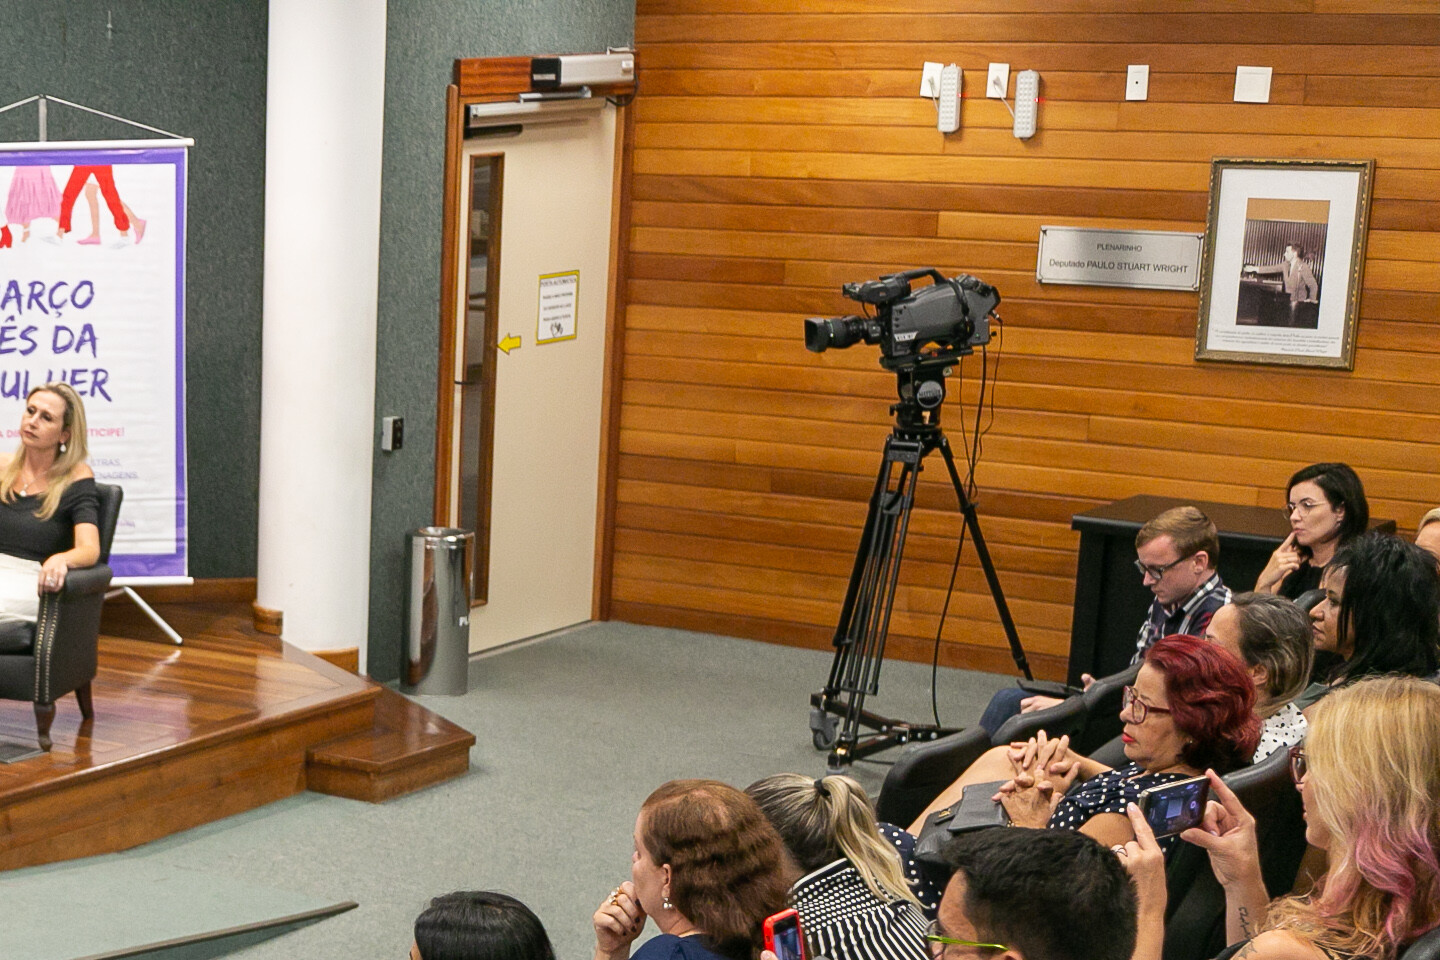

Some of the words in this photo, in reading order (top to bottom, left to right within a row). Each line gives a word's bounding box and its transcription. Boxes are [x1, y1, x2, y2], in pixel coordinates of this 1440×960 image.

[1096, 242, 1143, 253] PLENARINHO
[1049, 258, 1085, 270] Deputado
[1086, 259, 1115, 270] PAULO
[1116, 261, 1151, 273] STUART
[1152, 263, 1189, 274] WRIGHT
[51, 323, 99, 358] DA
